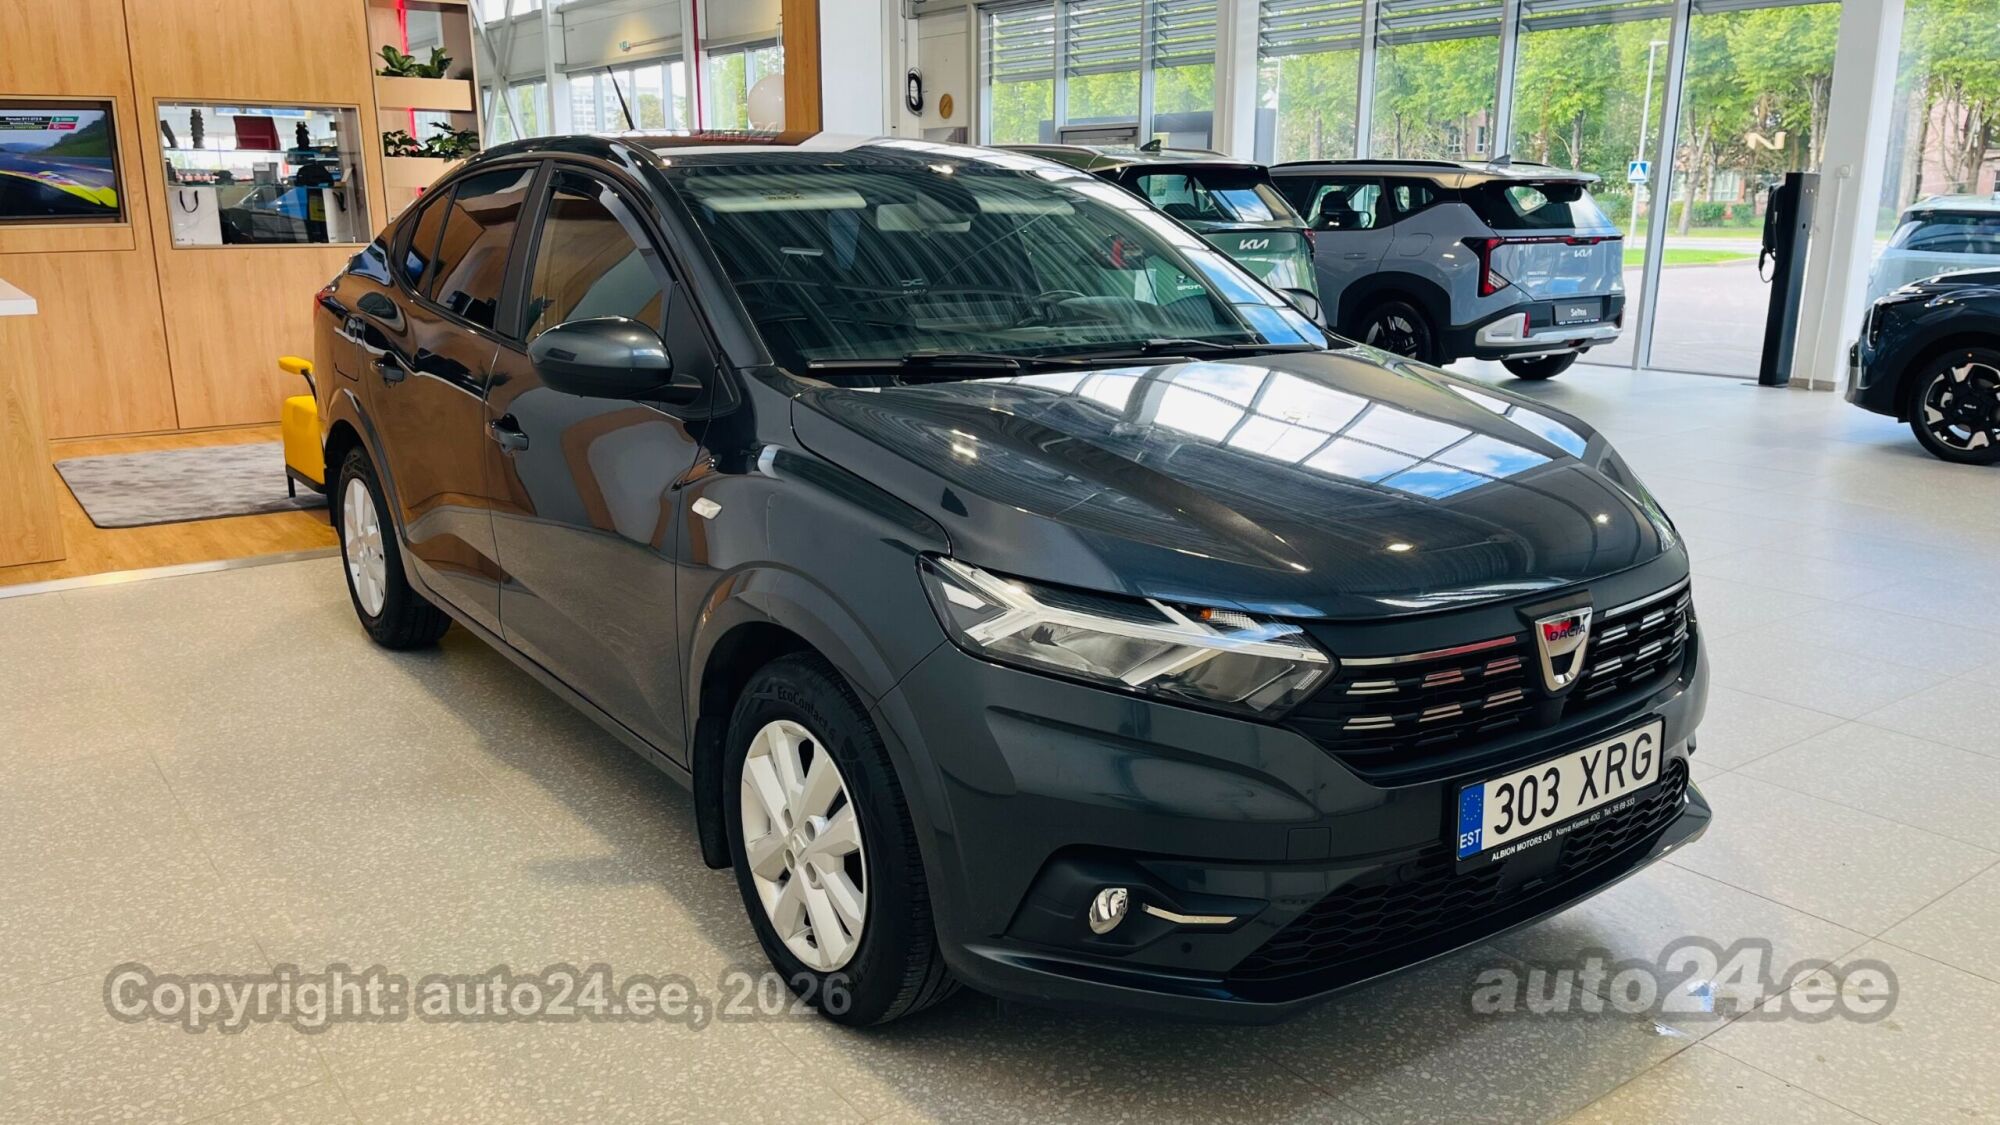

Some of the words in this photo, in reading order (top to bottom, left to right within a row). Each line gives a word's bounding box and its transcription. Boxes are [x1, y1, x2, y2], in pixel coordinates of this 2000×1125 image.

[1238, 238, 1269, 250] KIA
[1574, 248, 1593, 258] KIA
[1550, 623, 1586, 641] DACIA
[1494, 767, 1560, 835] 303
[1577, 732, 1653, 807] XRG
[1460, 828, 1482, 849] EST
[1491, 845, 1516, 862] ALBION
[1516, 835, 1542, 852] MOTORS
